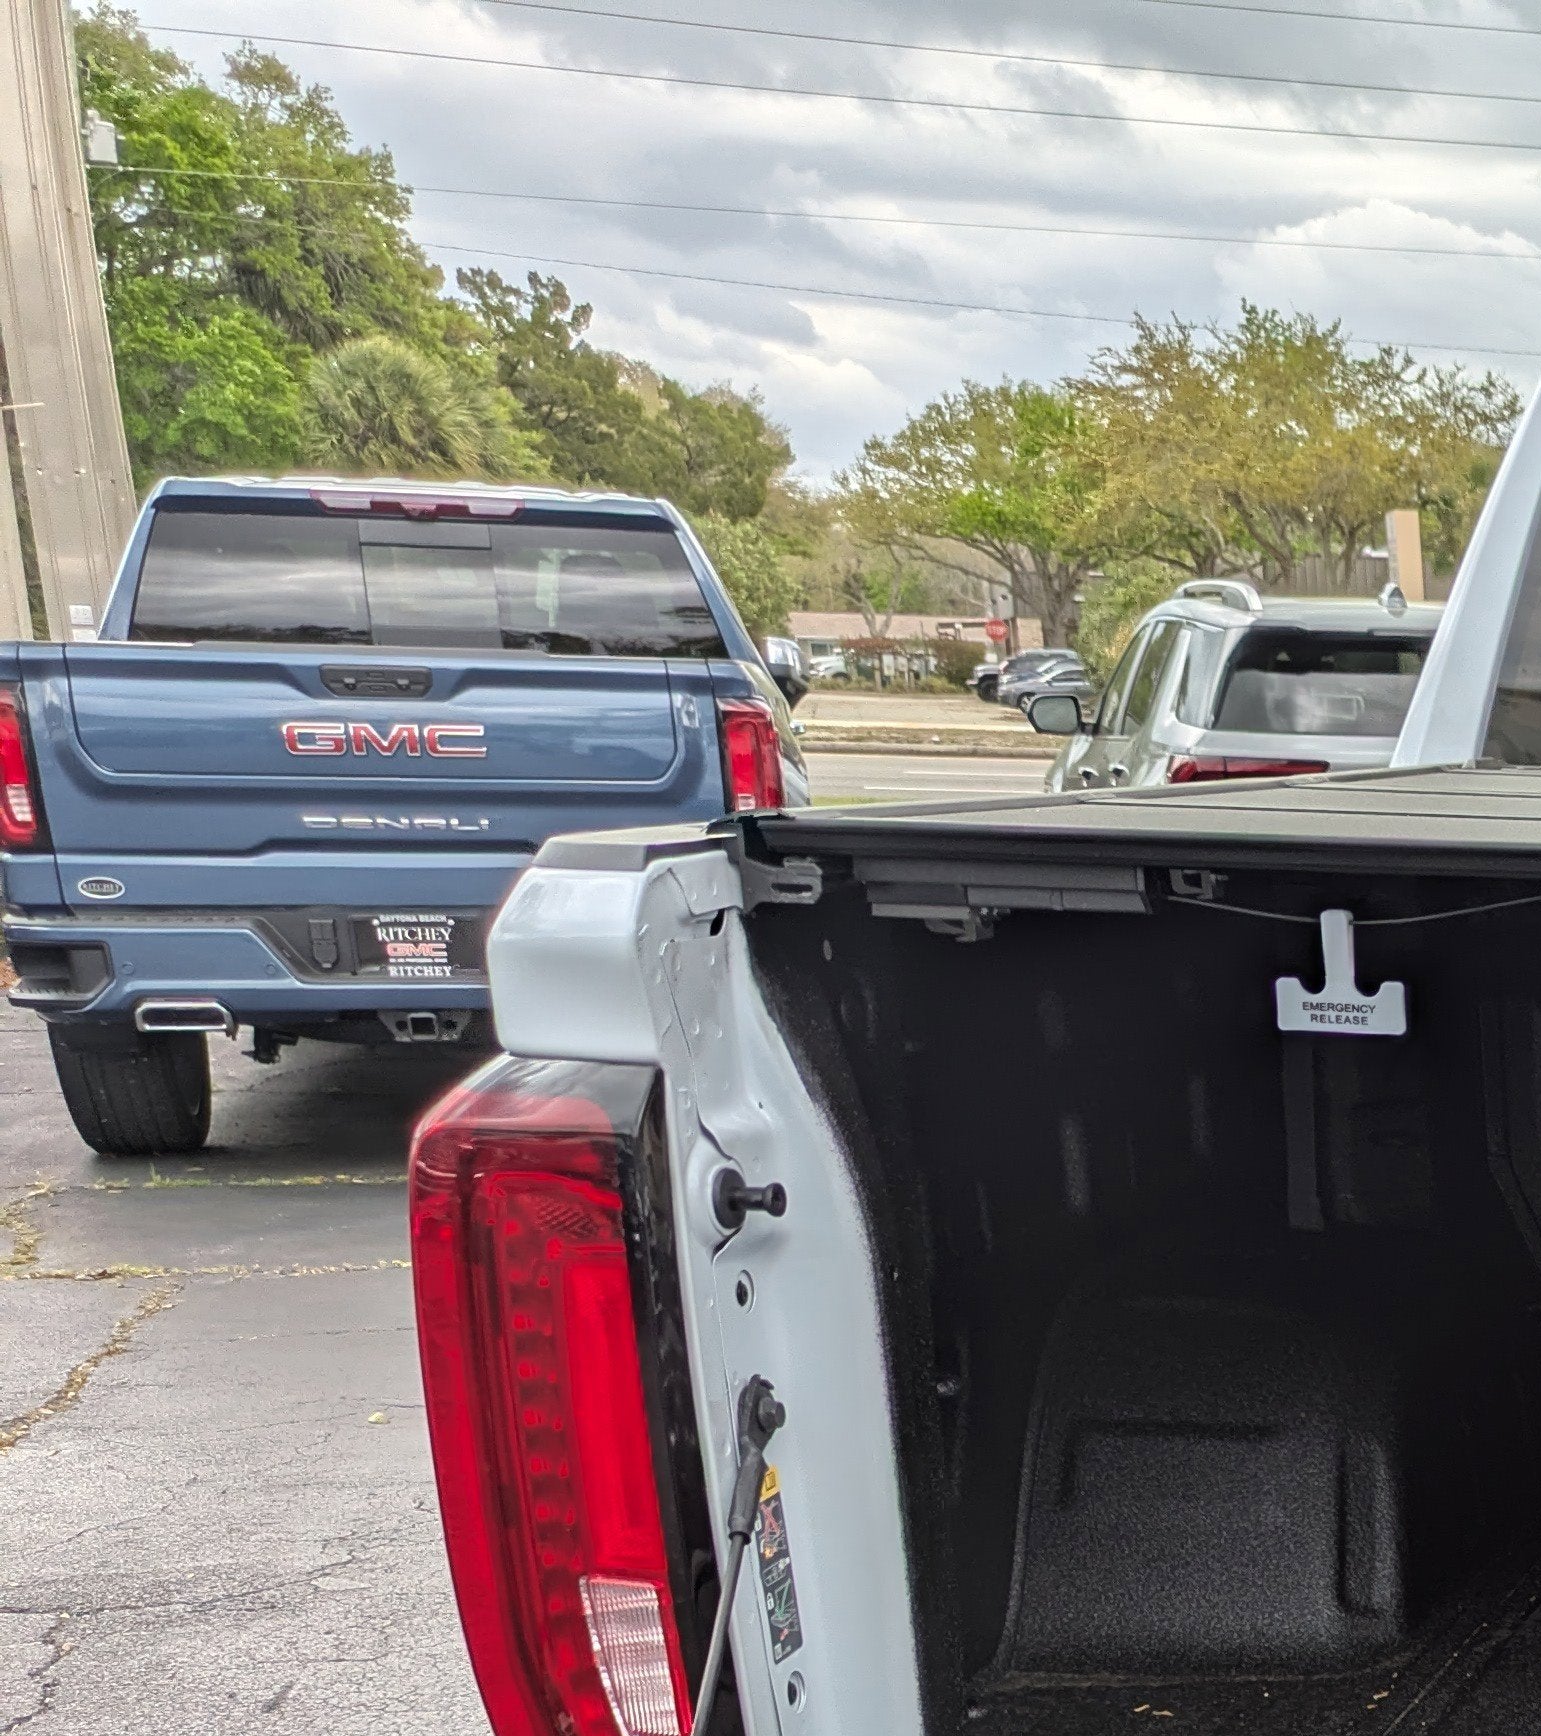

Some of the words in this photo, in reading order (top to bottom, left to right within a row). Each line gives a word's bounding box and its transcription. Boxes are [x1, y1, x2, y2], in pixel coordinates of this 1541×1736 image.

[282, 721, 488, 758] GMC
[302, 816, 490, 831] DENALI
[377, 926, 452, 942] RITCHEY
[386, 943, 448, 957] GMC
[388, 965, 452, 977] RITCHEY
[1302, 1001, 1376, 1014] EMERGENCY
[1310, 1013, 1369, 1025] RELEASE
